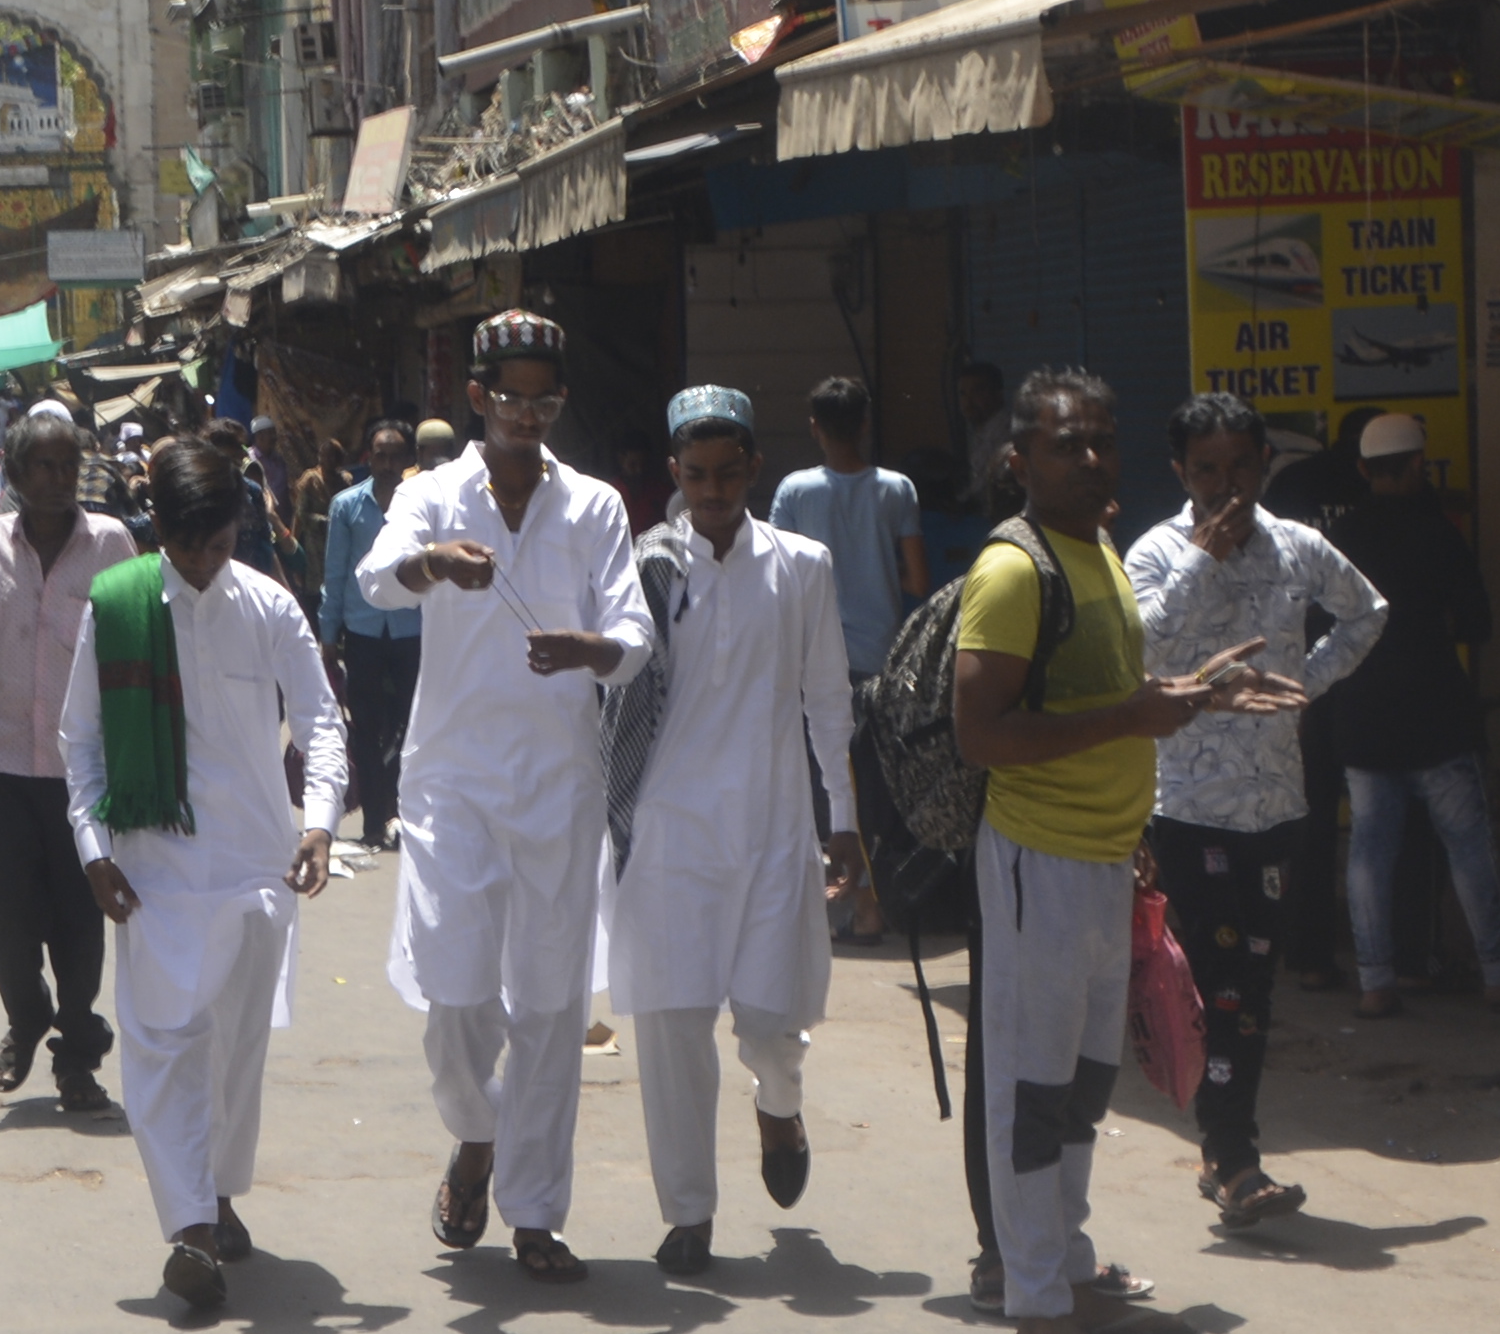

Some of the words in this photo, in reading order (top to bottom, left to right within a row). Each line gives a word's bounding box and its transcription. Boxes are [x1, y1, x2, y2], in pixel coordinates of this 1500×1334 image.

[1200, 143, 1446, 201] RESERVATION
[1347, 217, 1437, 251] TRAIN
[1342, 262, 1446, 297] TICKET
[1234, 320, 1291, 352] AIR
[1206, 364, 1321, 400] TICKET
